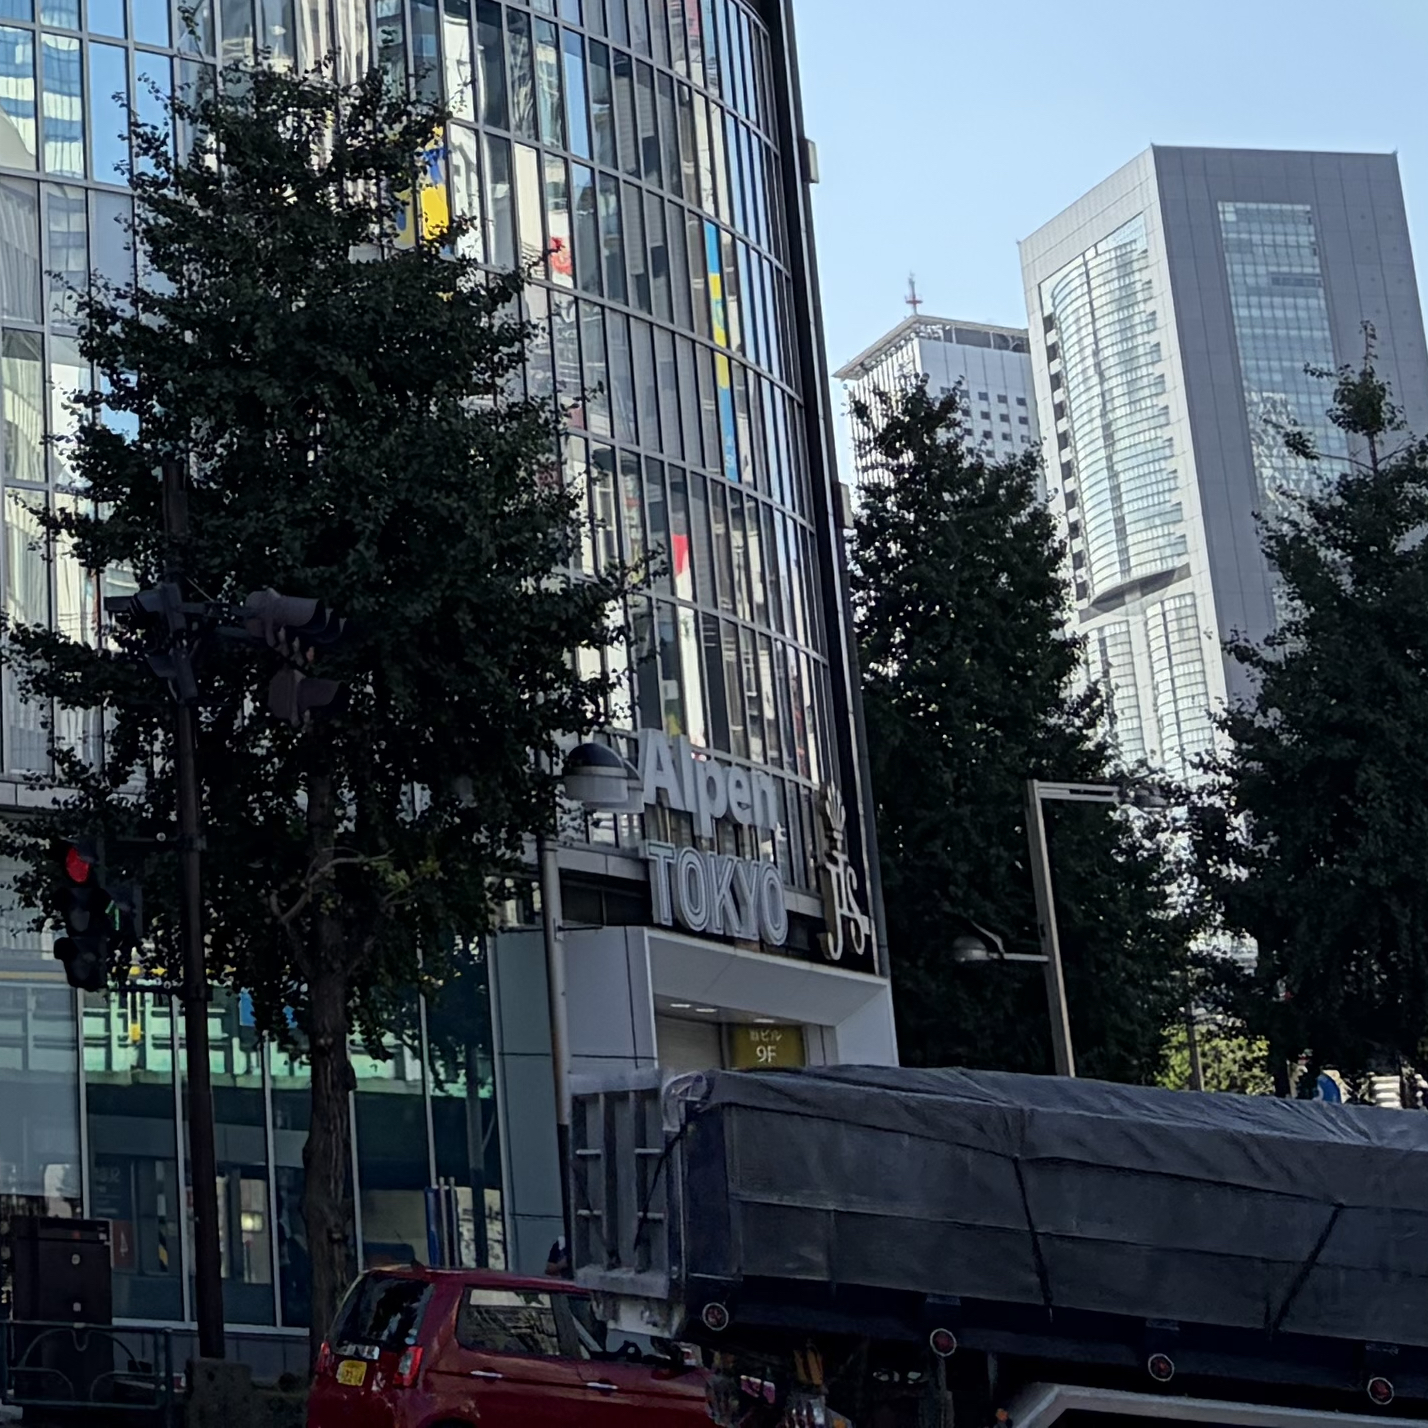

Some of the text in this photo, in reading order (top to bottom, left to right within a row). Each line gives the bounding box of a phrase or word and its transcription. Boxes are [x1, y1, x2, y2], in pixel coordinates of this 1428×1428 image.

[638, 726, 781, 839] Alpen
[639, 840, 789, 947] TOKYO
[755, 1045, 777, 1063] 9F
